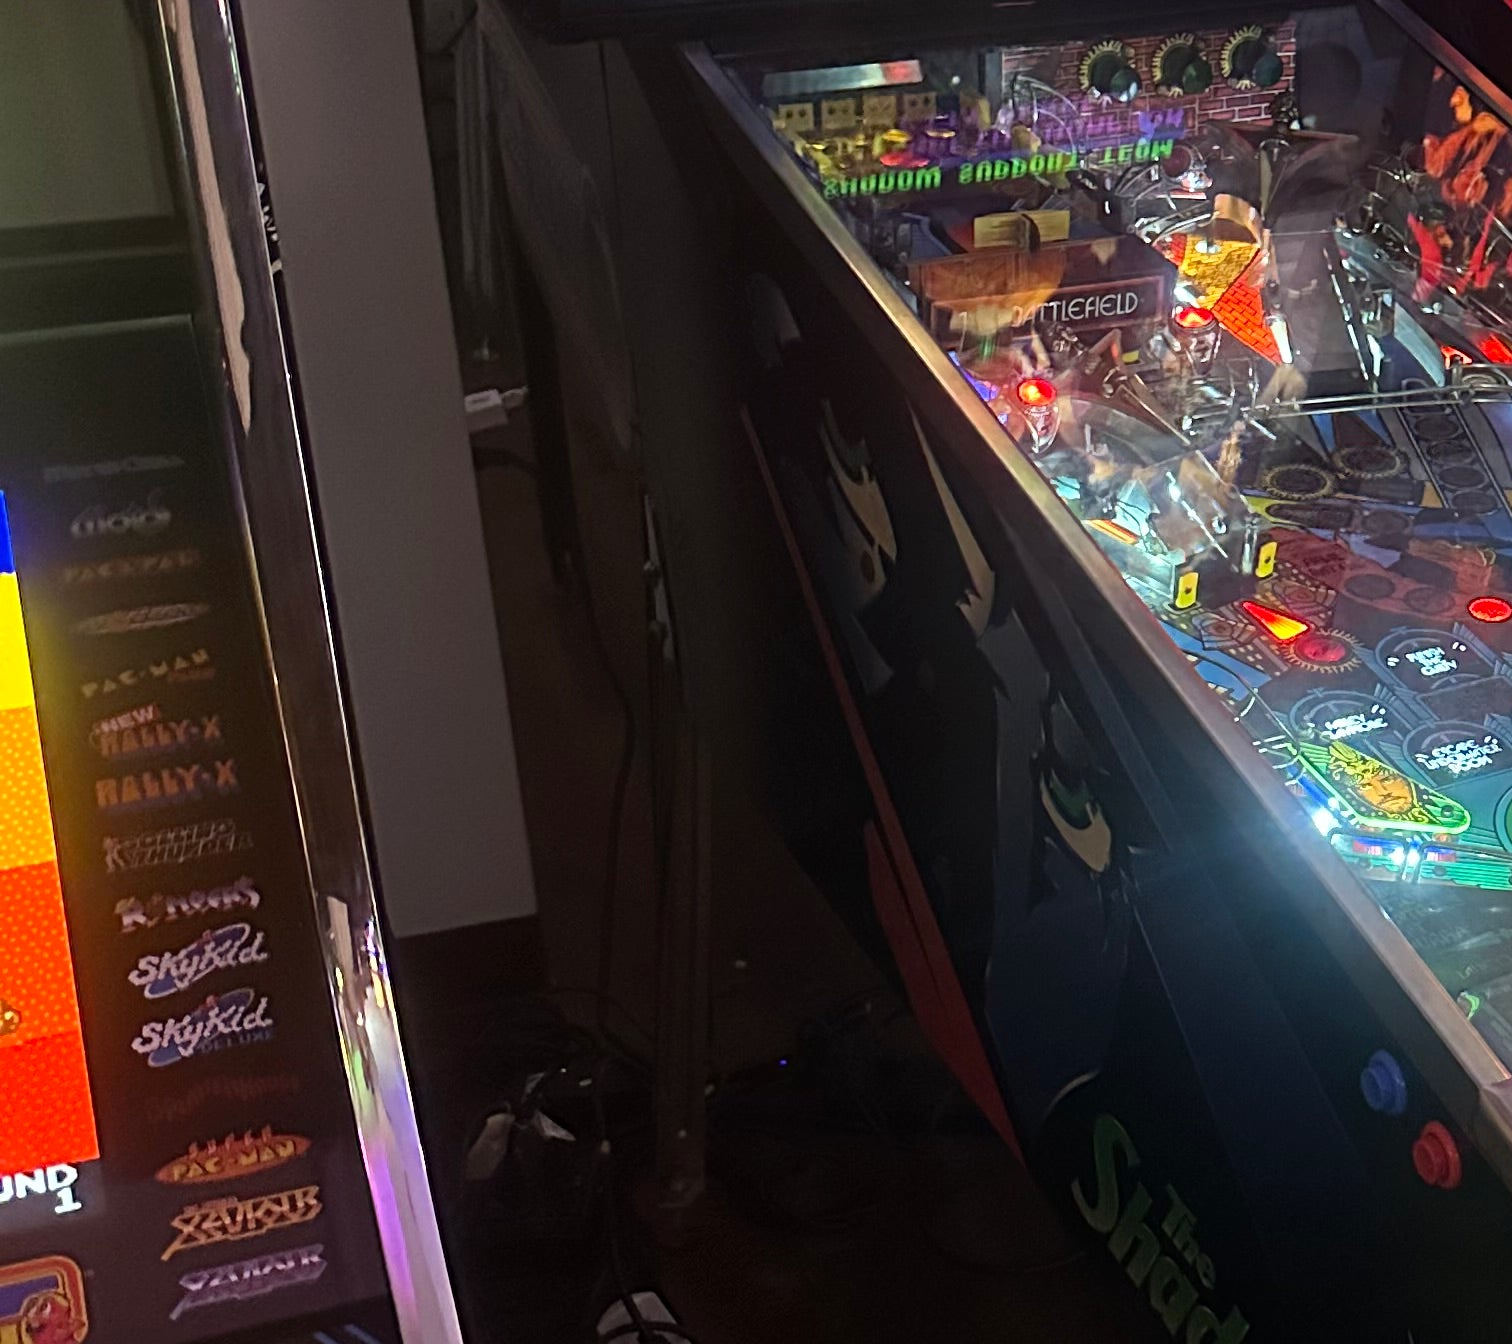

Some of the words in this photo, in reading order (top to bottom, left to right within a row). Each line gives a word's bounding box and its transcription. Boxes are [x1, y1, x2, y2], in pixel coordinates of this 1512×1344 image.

[101, 705, 157, 734] NEW
[95, 759, 238, 808] RALLY-X
[173, 1139, 297, 1181] PAC-MAN
[54, 1186, 82, 1214] 1
